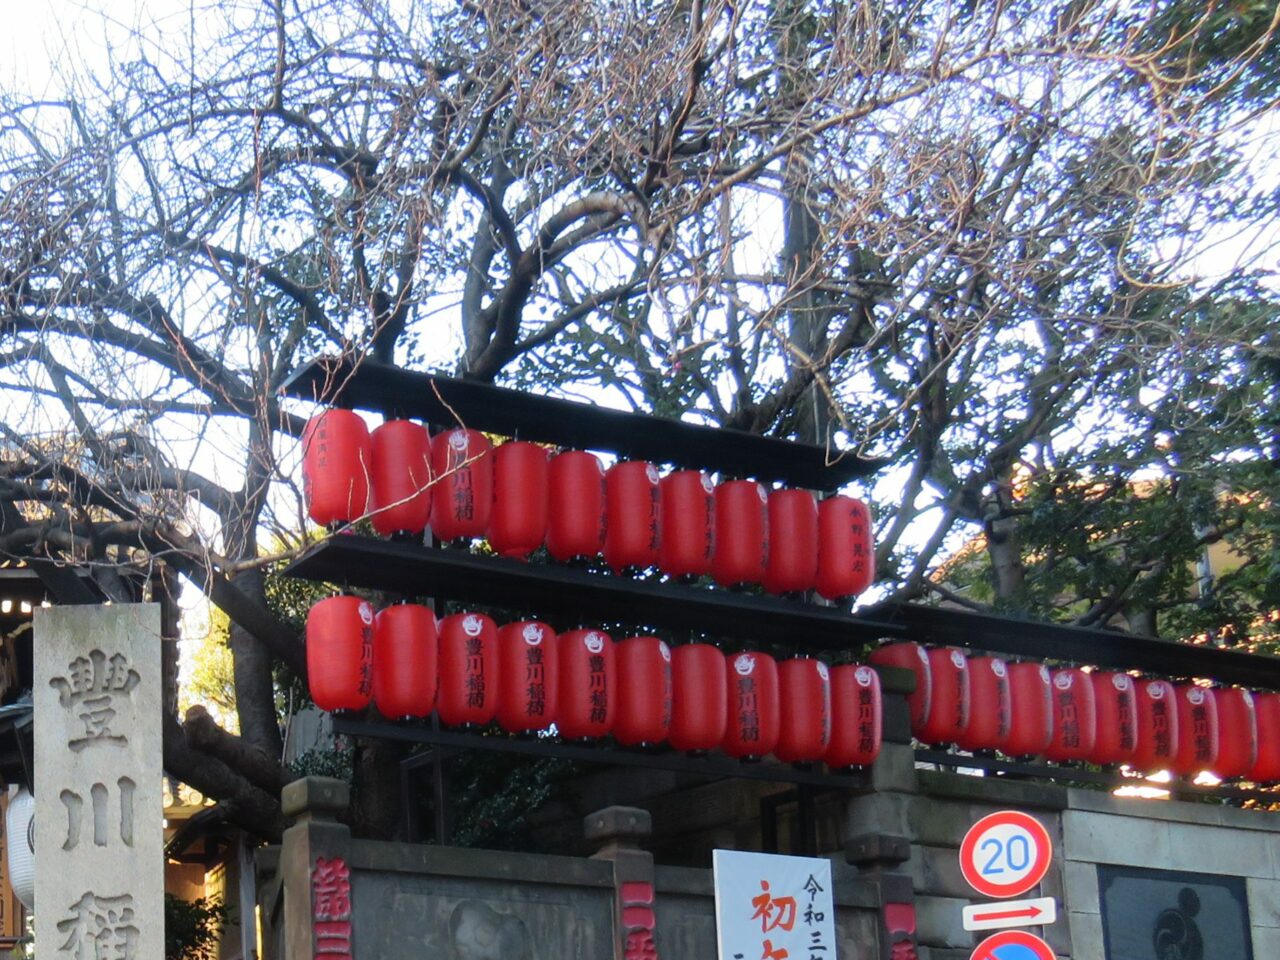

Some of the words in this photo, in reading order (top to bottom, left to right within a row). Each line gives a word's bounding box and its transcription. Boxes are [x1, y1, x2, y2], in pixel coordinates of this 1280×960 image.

[465, 638, 485, 709] 豊川稲荷
[526, 647, 546, 717] 豊川稲荷
[589, 655, 608, 724] 豊川稲荷
[738, 678, 760, 743] 豊川稲荷
[981, 835, 1030, 875] 20
